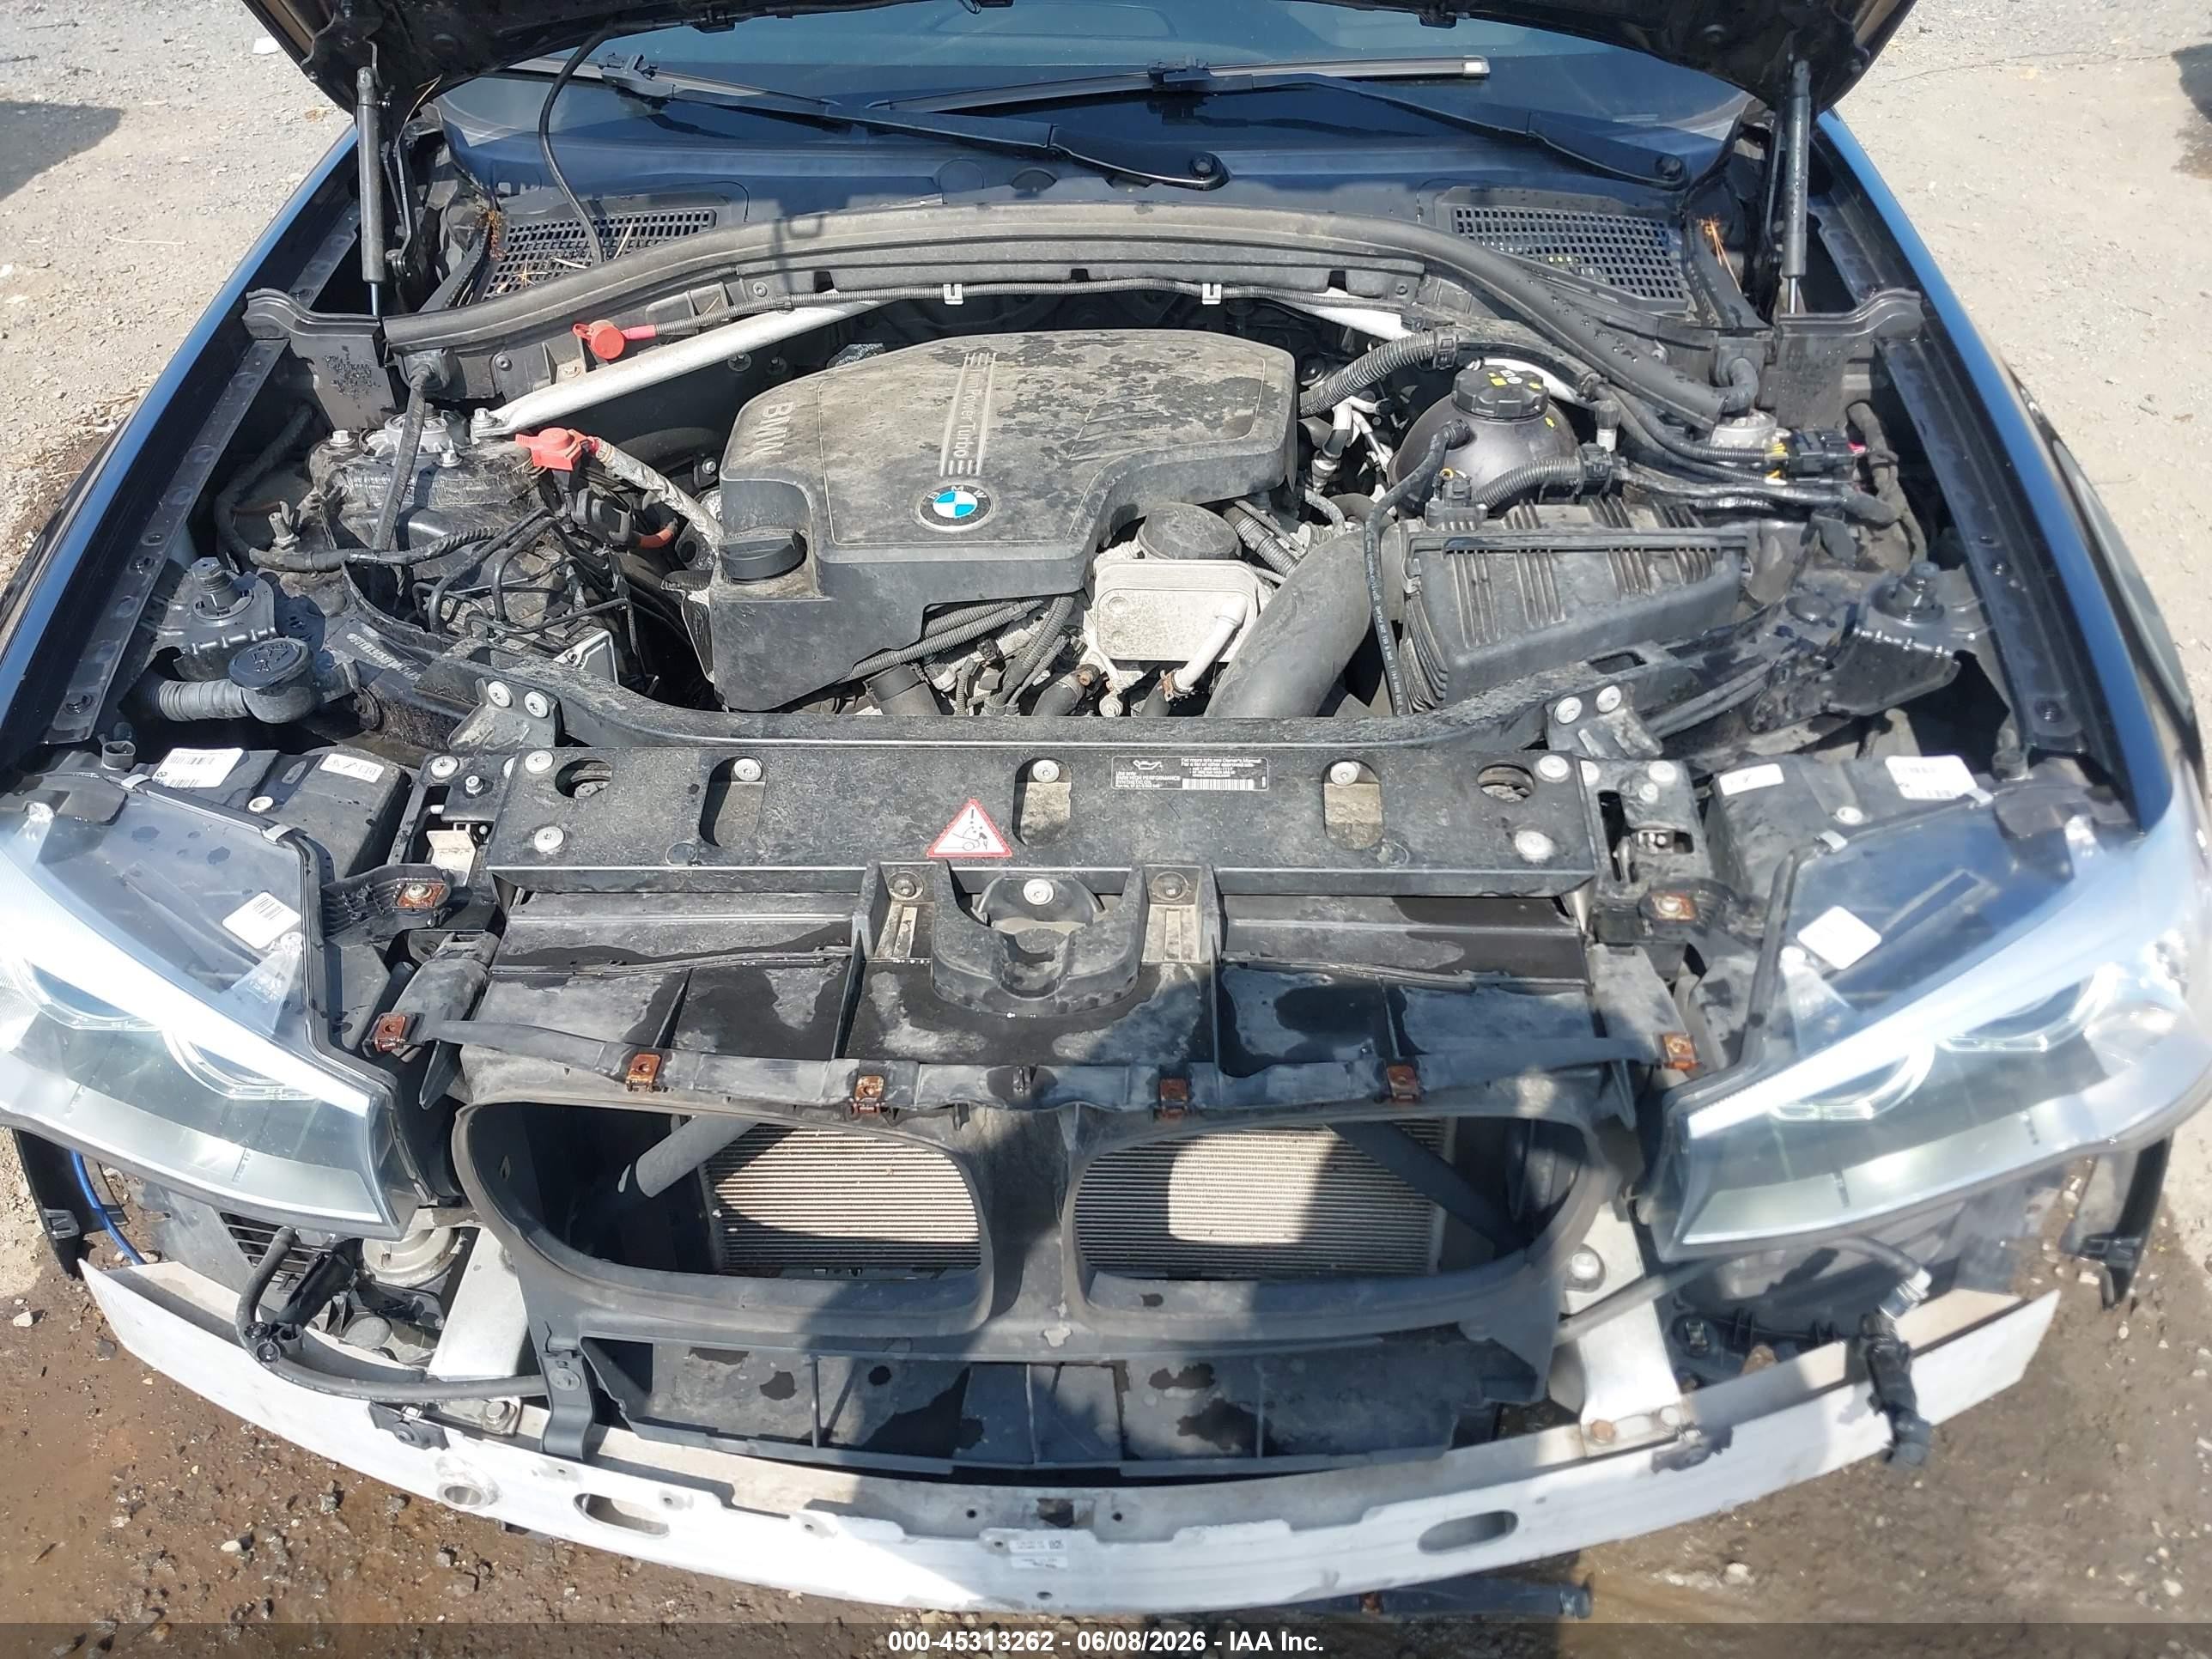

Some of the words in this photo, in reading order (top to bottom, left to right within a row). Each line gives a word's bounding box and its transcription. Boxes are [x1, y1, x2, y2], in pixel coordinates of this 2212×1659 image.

[961, 367, 986, 421] TwinPower
[752, 402, 794, 455] BMW
[952, 422, 976, 458] Turbo
